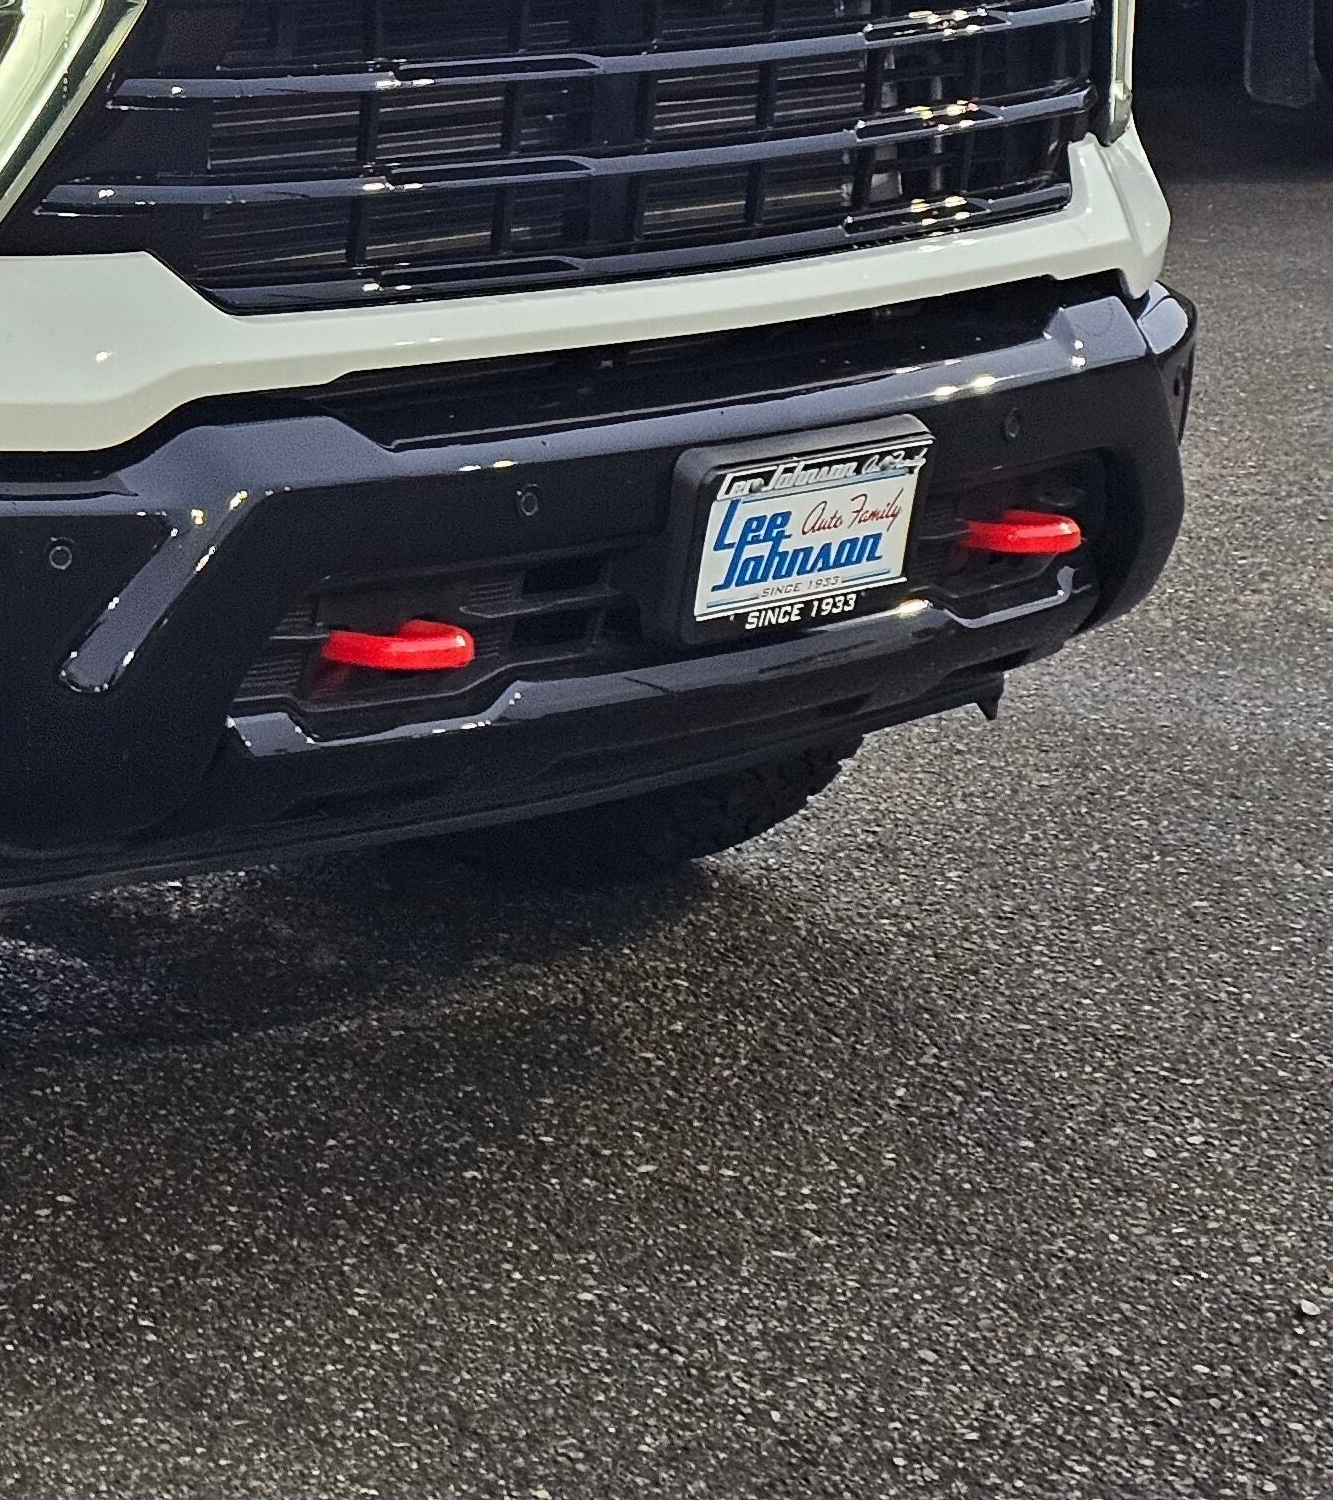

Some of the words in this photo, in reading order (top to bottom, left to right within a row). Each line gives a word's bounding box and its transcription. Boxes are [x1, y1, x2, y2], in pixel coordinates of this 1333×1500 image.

[712, 498, 793, 551] Lee
[801, 500, 844, 536] Auto
[847, 488, 904, 532] Family
[711, 530, 883, 593] Johnson
[744, 601, 803, 630] SINCE
[810, 593, 858, 618] 1933
[761, 581, 801, 599] SINCE
[806, 575, 840, 590] 1933
